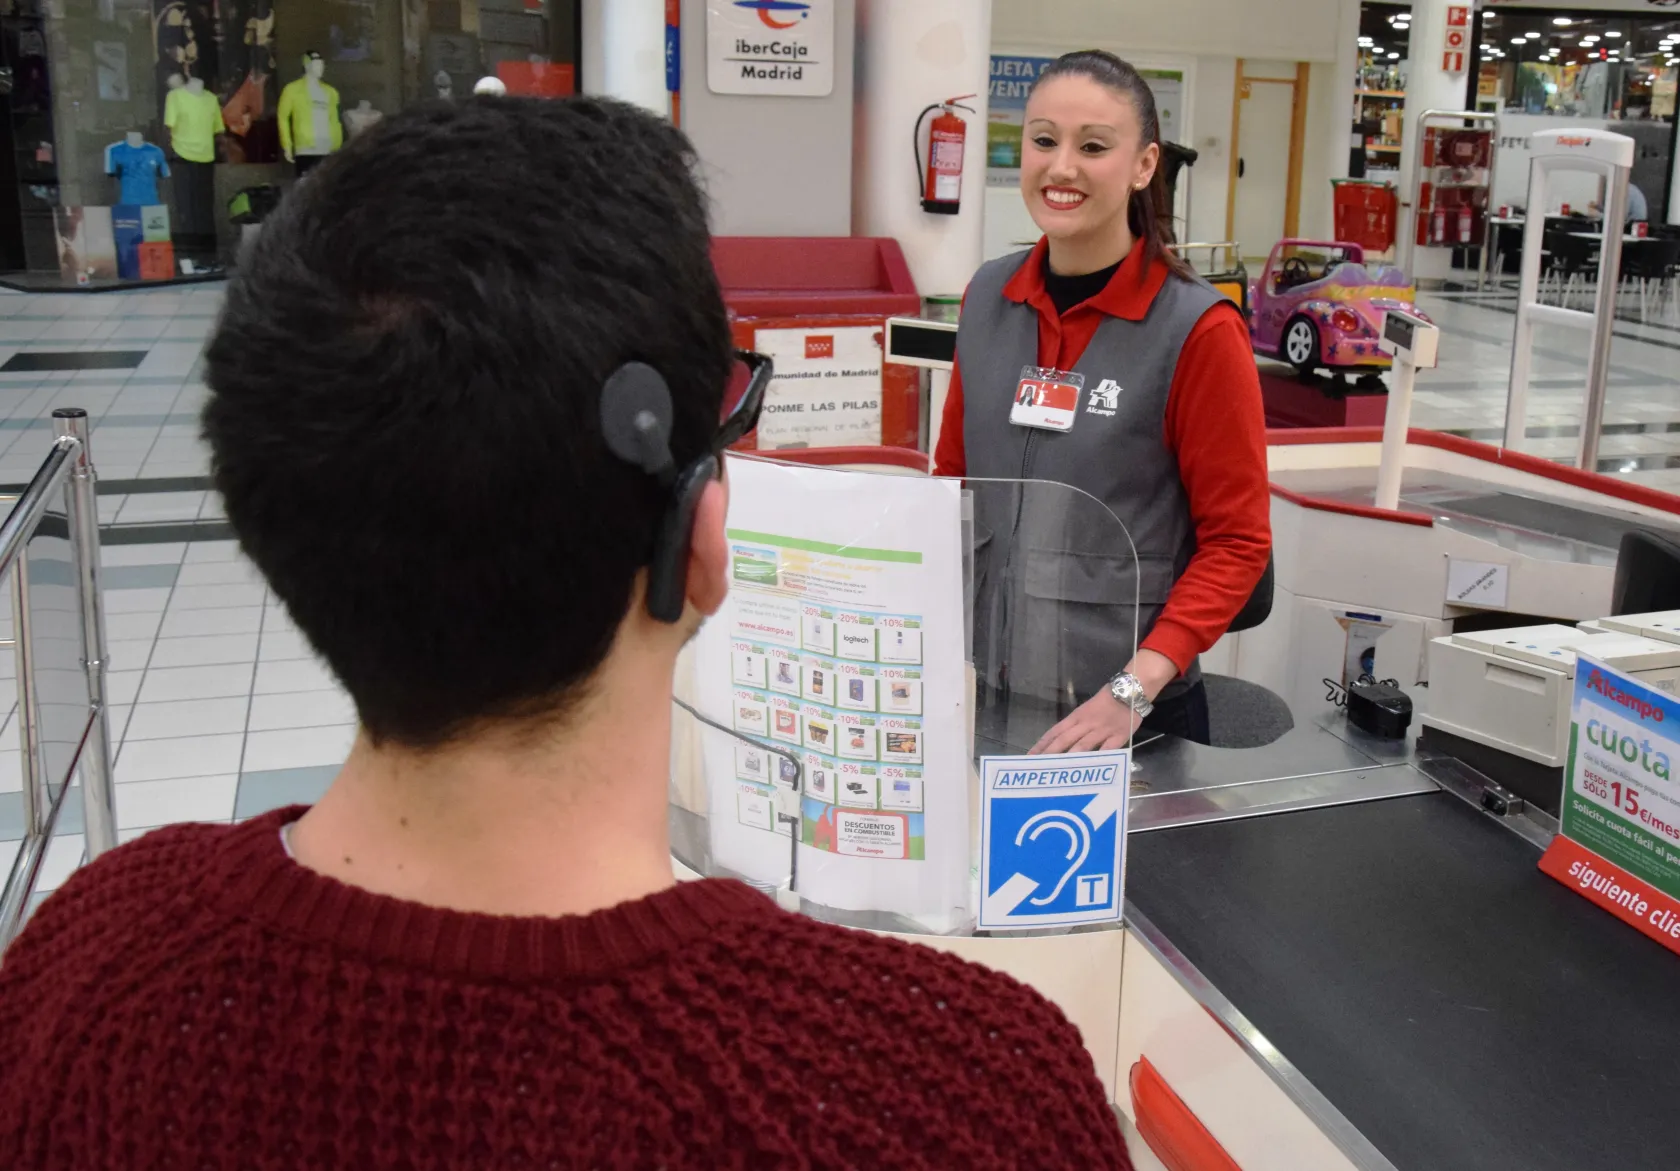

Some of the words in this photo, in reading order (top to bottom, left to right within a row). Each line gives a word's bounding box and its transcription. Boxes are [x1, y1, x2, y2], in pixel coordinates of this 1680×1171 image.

[735, 39, 808, 59] iberCaja
[740, 65, 803, 80] Madrid
[769, 370, 822, 380] omunidad
[824, 370, 838, 378] de
[841, 369, 879, 377] Madrid
[811, 402, 836, 412] LAS
[842, 400, 878, 410] PILAS
[1085, 406, 1116, 417] Alcampo
[880, 618, 903, 628] -10%
[843, 634, 869, 644] logitech
[880, 669, 904, 679] -10%
[1585, 668, 1665, 722] Alcampo
[838, 715, 859, 725] -10%
[881, 720, 905, 729] -10%
[1586, 718, 1672, 782] cuota
[840, 763, 859, 775] -5%
[883, 767, 904, 778] -5%
[998, 767, 1114, 786] AMPETRONIC
[1584, 768, 1608, 788] DESDE
[1583, 779, 1607, 799] SÓLO
[844, 820, 896, 831] DESCUENTOS
[1572, 799, 1605, 823] Solicita
[1606, 818, 1632, 839] cuota
[1633, 832, 1654, 851] fácil
[1655, 846, 1664, 857] al
[1081, 876, 1104, 903] T
[1568, 861, 1648, 916] siguiente
[1649, 909, 1680, 938] clie
